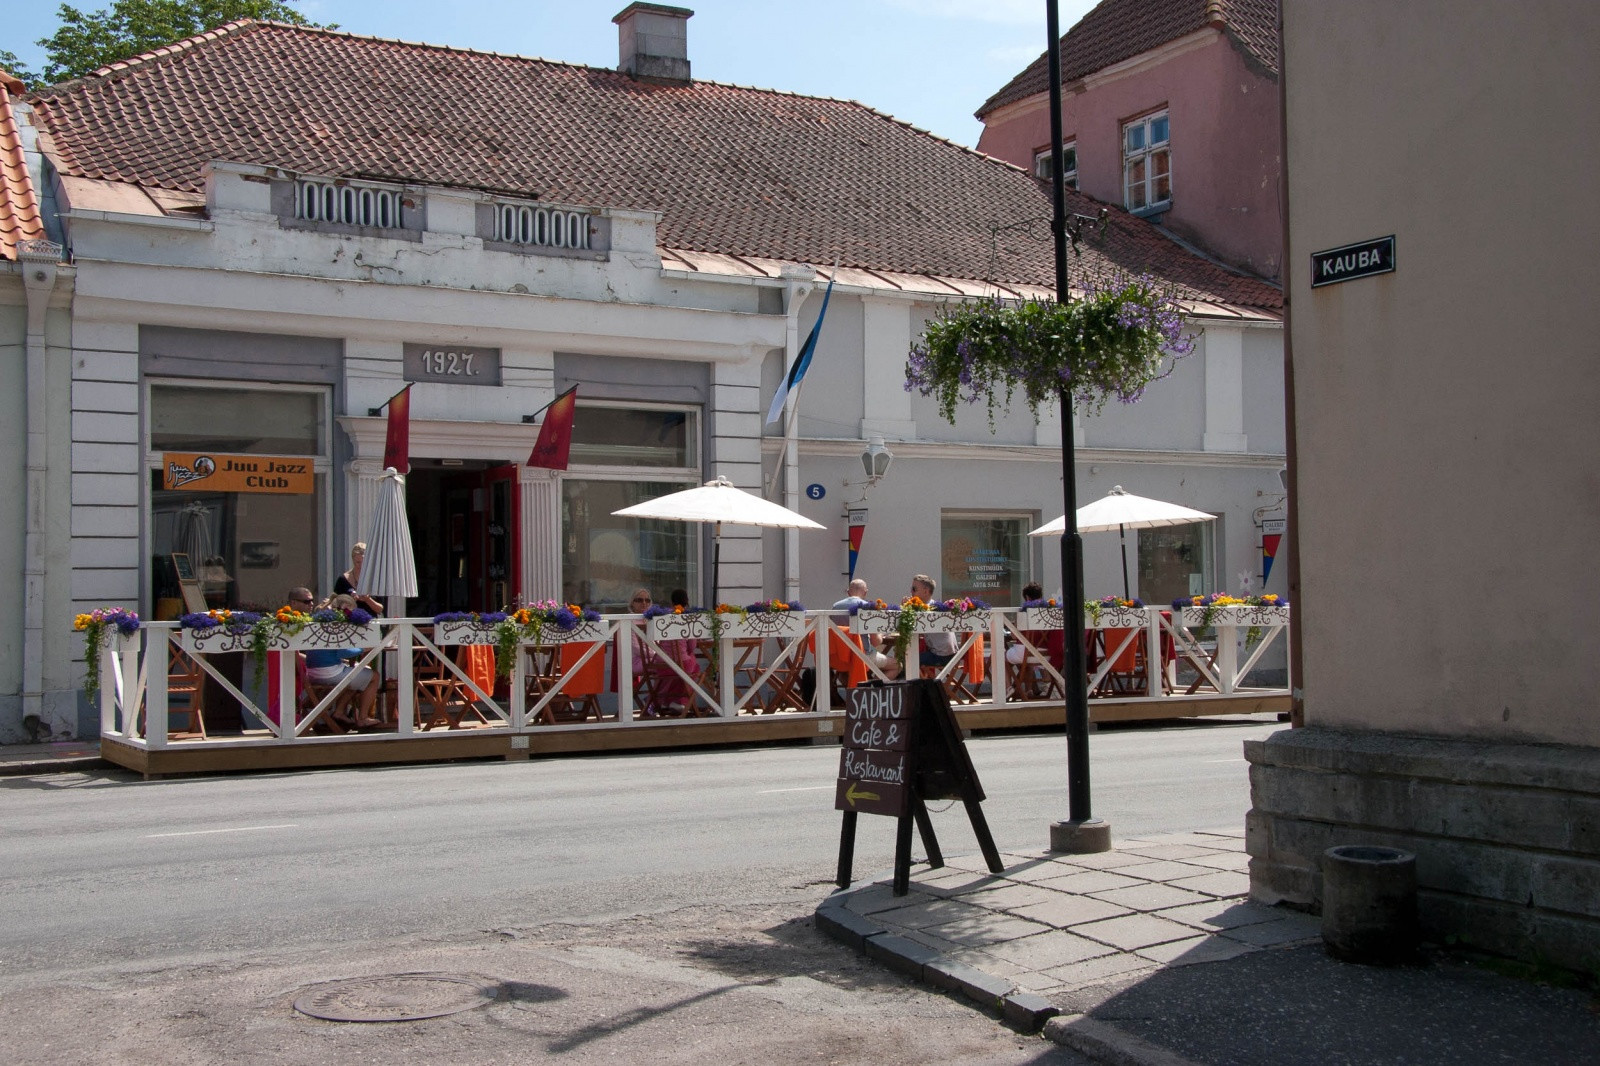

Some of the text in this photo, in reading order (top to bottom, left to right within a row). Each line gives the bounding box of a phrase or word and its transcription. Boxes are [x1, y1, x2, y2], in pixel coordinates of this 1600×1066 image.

[1322, 248, 1381, 276] KAUBA
[422, 350, 479, 376] 1927.
[222, 460, 307, 474] Juu Jazz
[246, 475, 289, 488] Club
[812, 487, 820, 498] 5
[849, 687, 902, 720] SADHU
[852, 720, 900, 747] Cafe &
[845, 750, 904, 783] Restaurant
